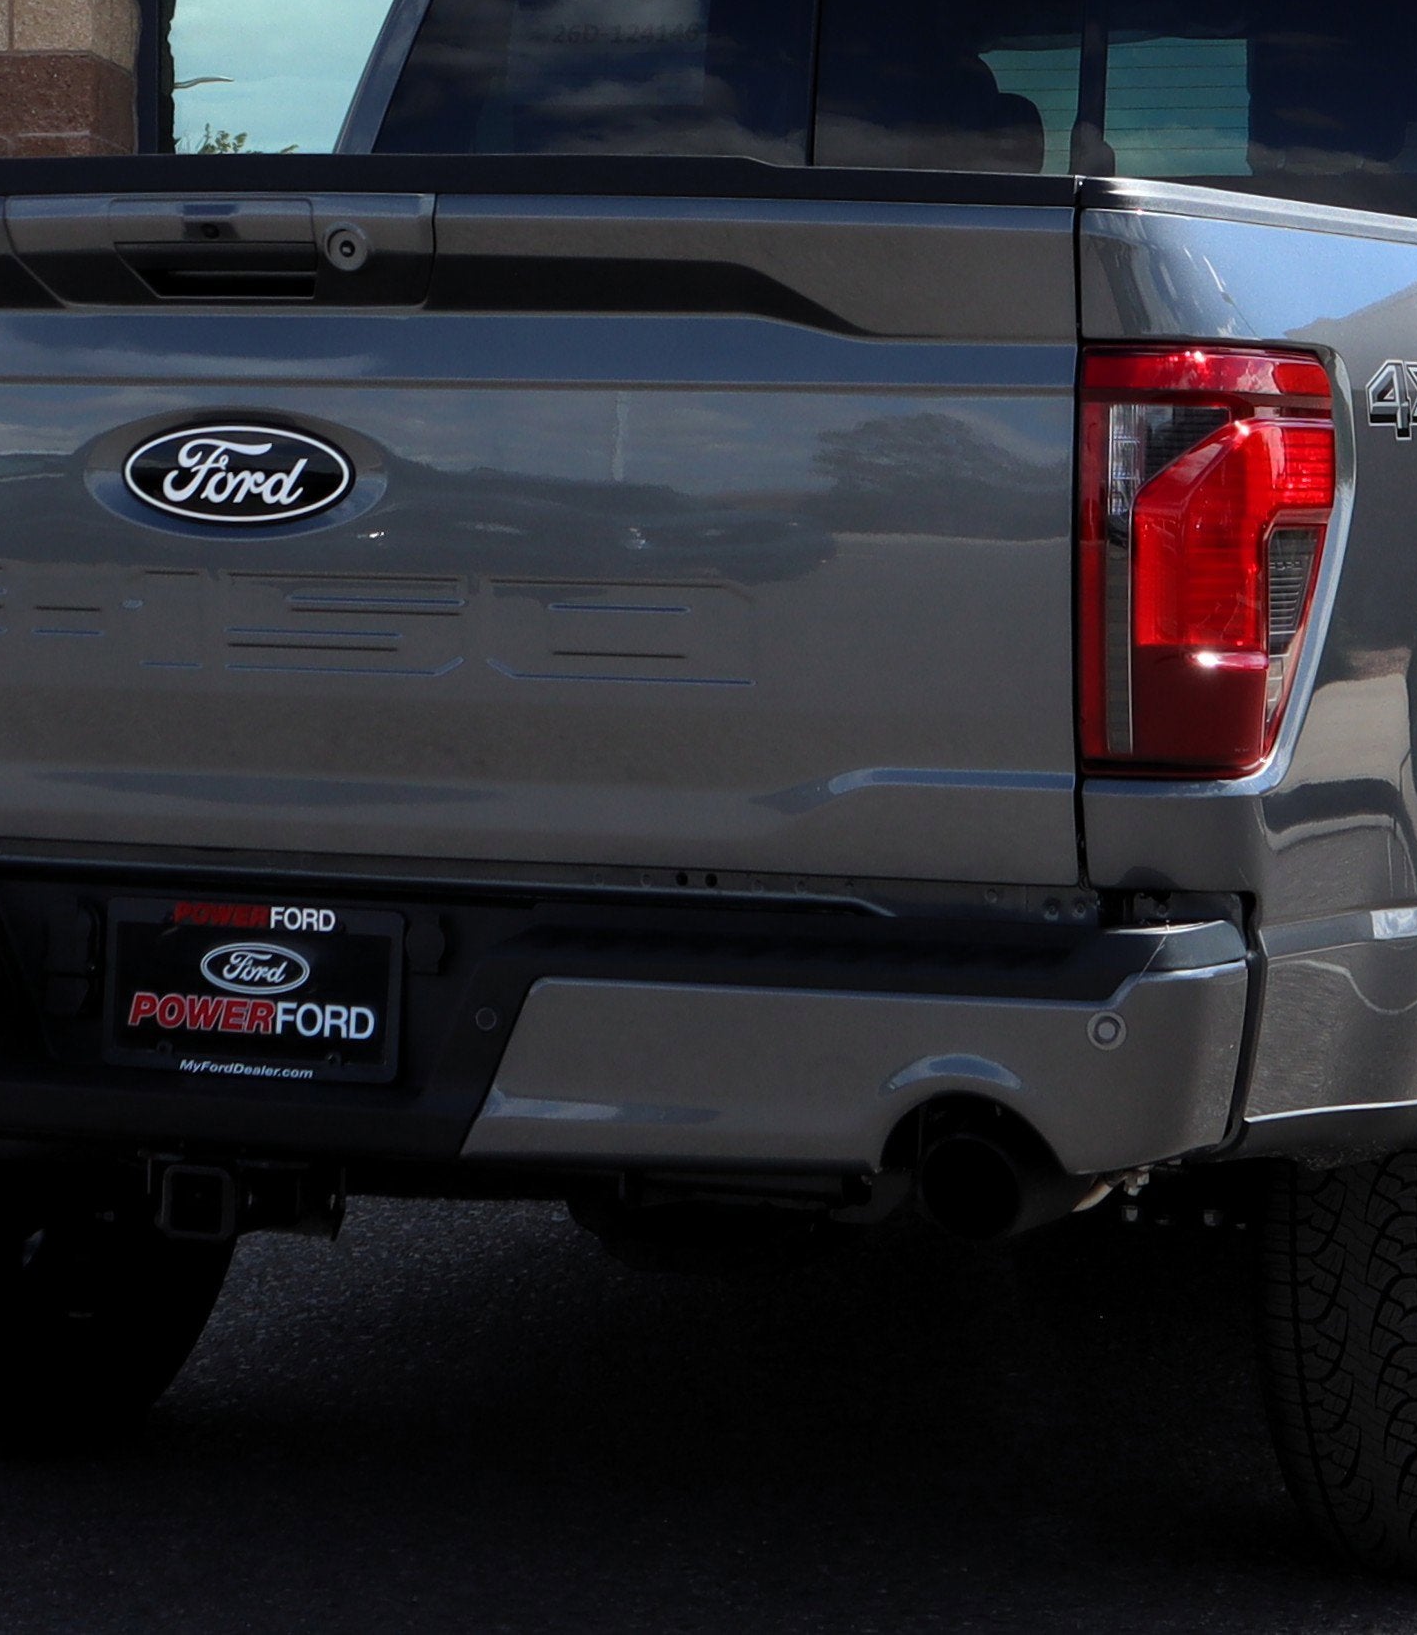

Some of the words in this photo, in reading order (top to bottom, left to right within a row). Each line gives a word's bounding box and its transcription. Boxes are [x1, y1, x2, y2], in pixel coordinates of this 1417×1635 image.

[162, 438, 308, 505] Ford
[222, 950, 286, 984] Ford
[127, 992, 376, 1039] POWERFORD
[179, 1058, 314, 1080] MyFordDealer.com
